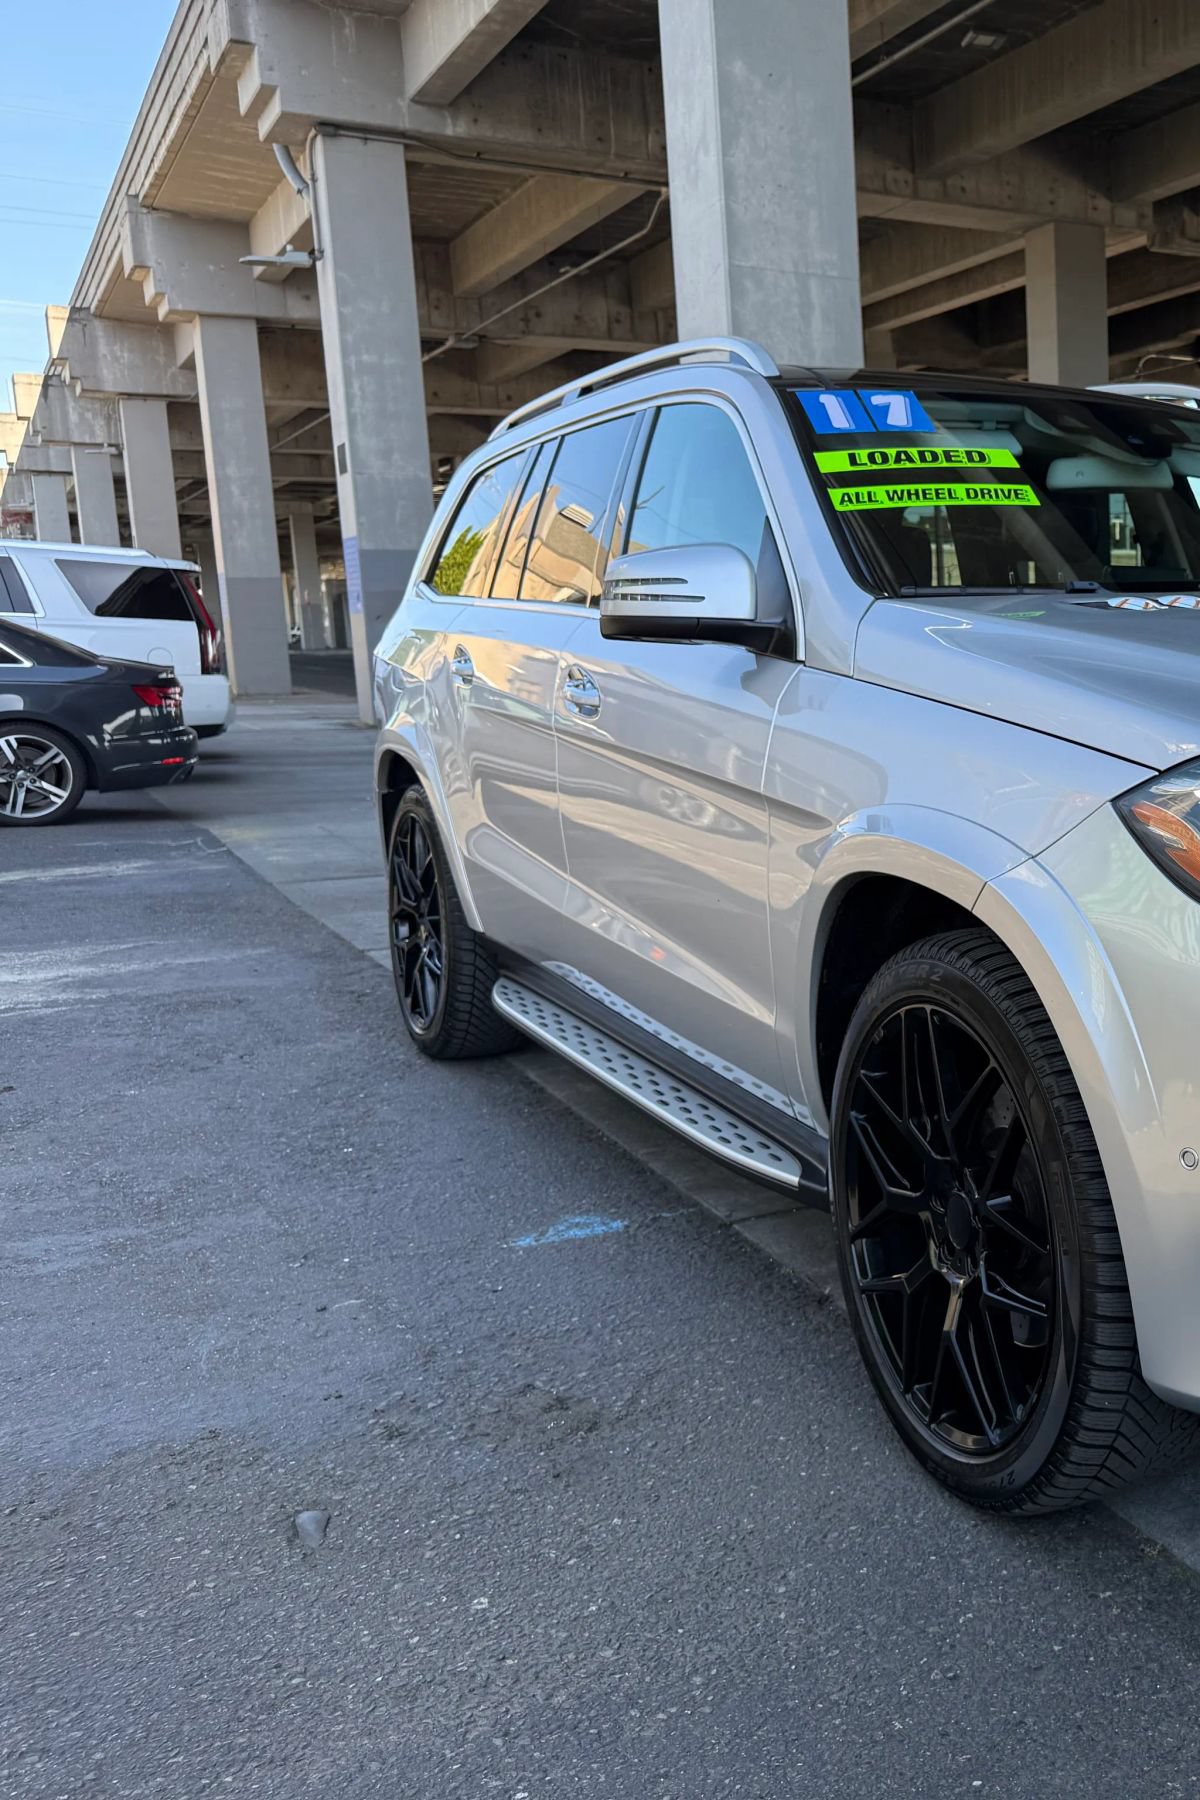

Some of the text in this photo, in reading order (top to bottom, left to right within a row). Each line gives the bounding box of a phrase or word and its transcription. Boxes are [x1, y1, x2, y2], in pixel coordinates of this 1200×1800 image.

[848, 449, 992, 468] LOADED
[839, 488, 1030, 506] ALL WHEEL DRIVE
